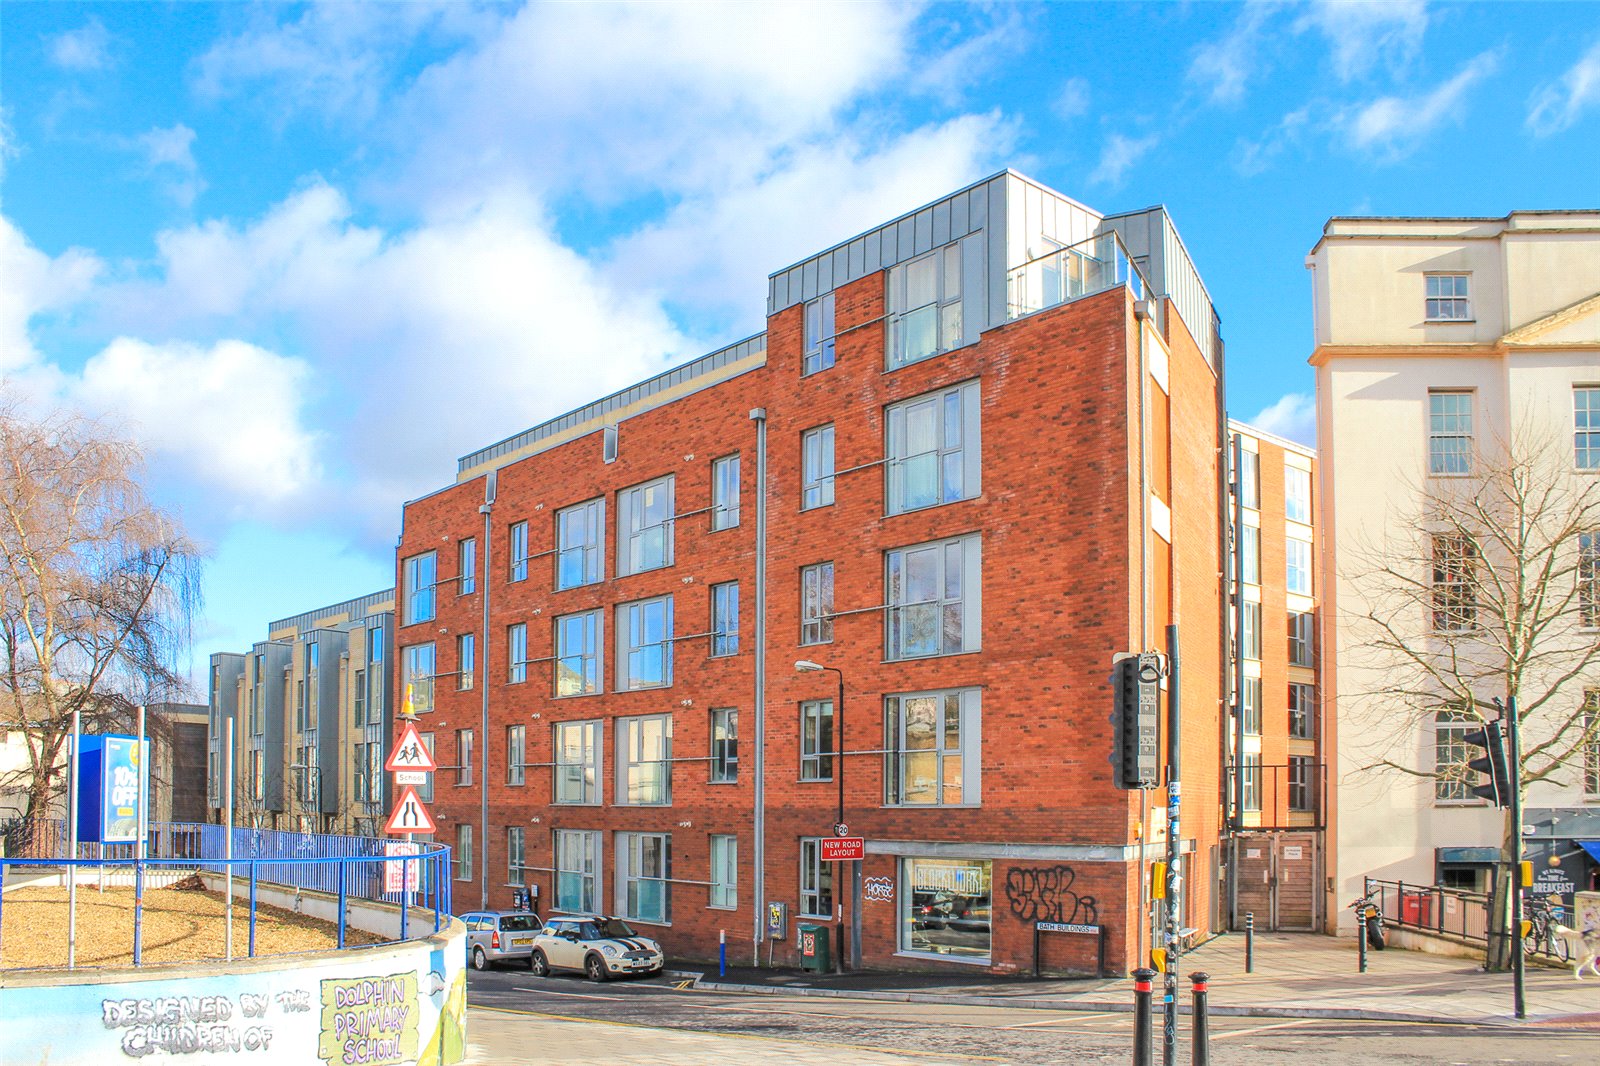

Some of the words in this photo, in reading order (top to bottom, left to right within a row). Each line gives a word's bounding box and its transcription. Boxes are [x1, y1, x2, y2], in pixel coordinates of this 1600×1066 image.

[112, 786, 138, 806] OFF
[839, 826, 848, 834] 20
[824, 841, 840, 849] NEW
[829, 849, 856, 857] LAYOUT
[1532, 882, 1575, 893] BREAKFAST
[1039, 922, 1055, 930] BATH
[1057, 924, 1090, 933] BUILDINGS
[333, 978, 405, 1010] DOLPHIN
[102, 996, 234, 1030] DESIGNED
[239, 993, 270, 1018] BY
[276, 989, 311, 1014] THE
[333, 1005, 409, 1041] PRIMARY
[121, 1025, 241, 1058] CHILDREN
[243, 1025, 276, 1051] OF
[342, 1033, 402, 1065] SCHOOL
